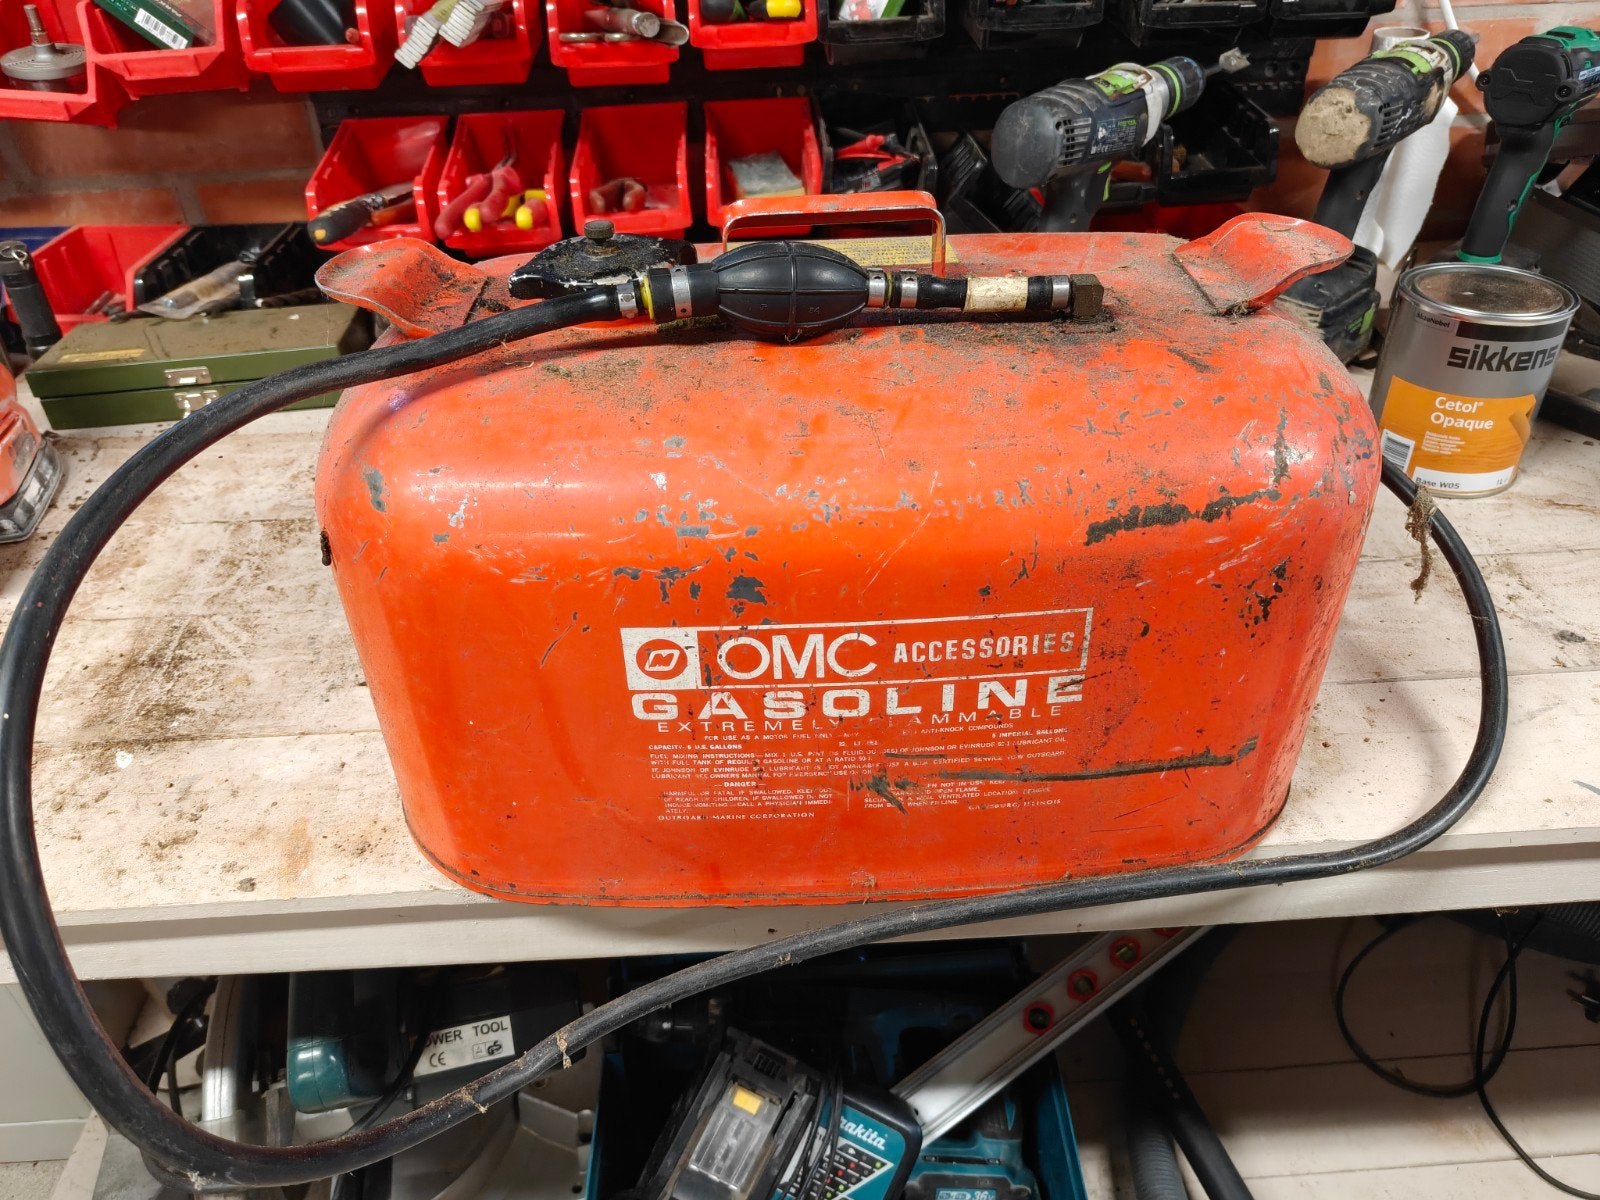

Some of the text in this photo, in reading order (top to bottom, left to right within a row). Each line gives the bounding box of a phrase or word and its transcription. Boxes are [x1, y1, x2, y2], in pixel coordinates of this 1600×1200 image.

[1447, 344, 1559, 372] sikkens
[1430, 412, 1494, 431] Opaque
[1415, 477, 1437, 488] Base
[717, 631, 1075, 680] OMC ACCESSORIES
[631, 674, 1087, 720] GASOLINE
[657, 719, 840, 733] EXTREMELY
[911, 744, 945, 753] JOHNSON
[472, 1020, 509, 1037] TOOL
